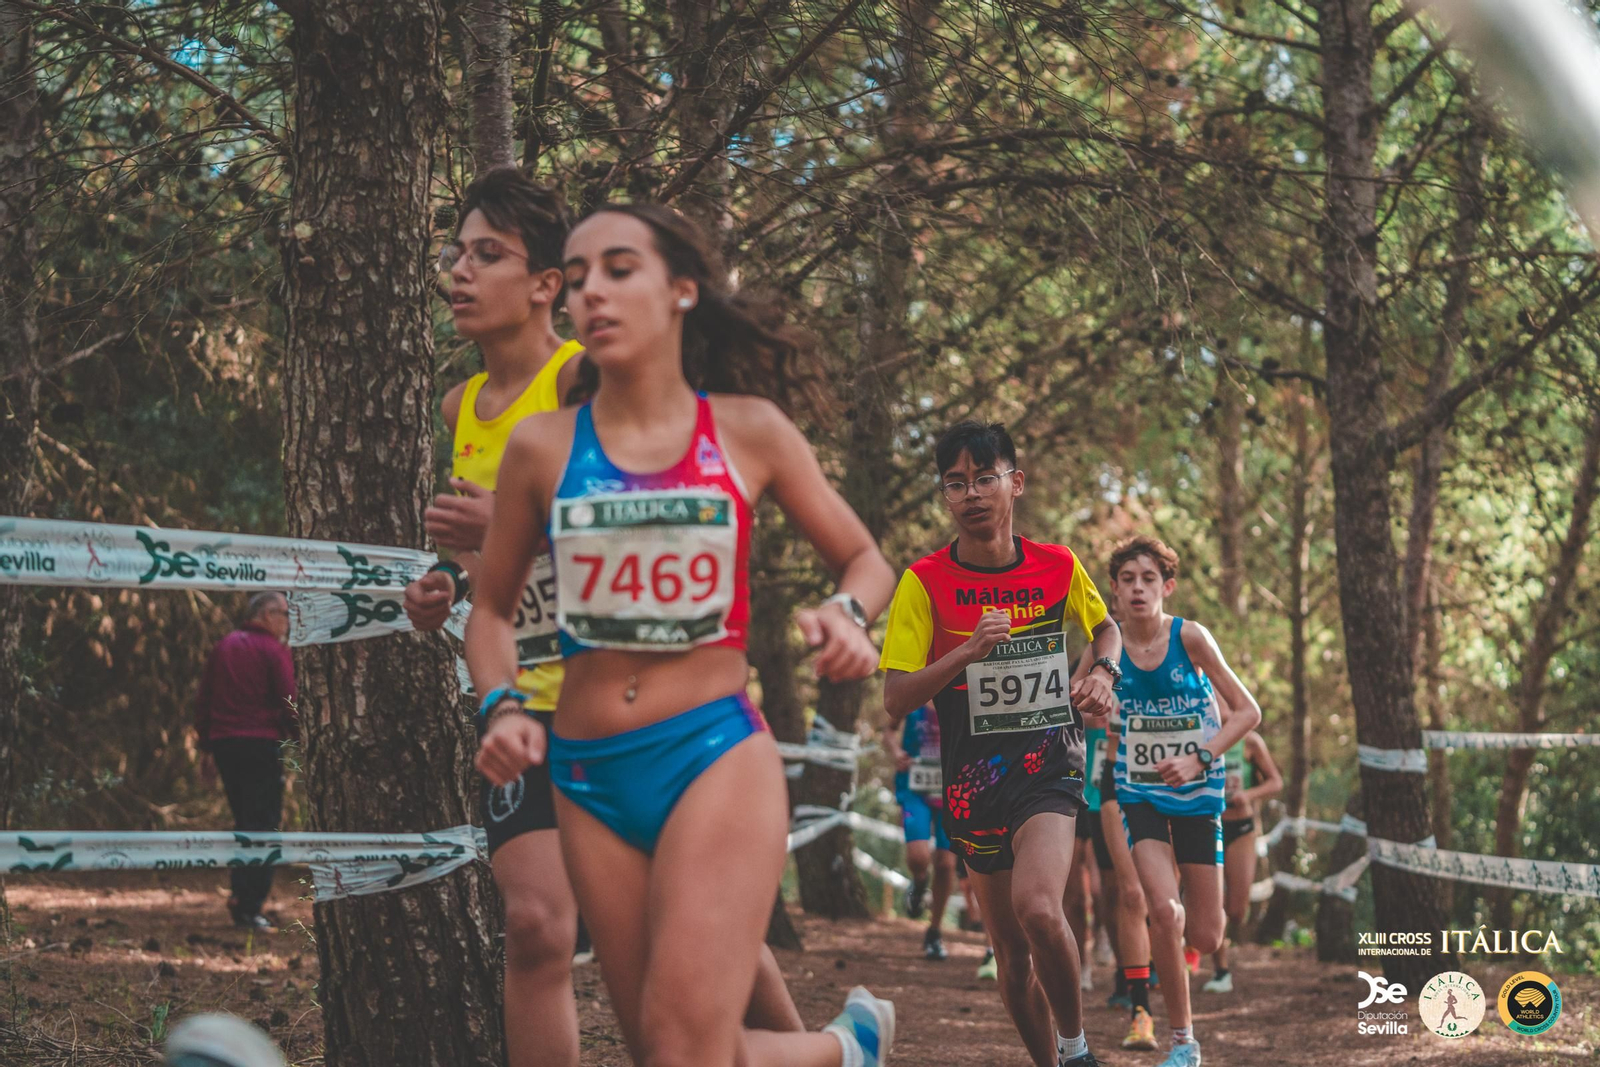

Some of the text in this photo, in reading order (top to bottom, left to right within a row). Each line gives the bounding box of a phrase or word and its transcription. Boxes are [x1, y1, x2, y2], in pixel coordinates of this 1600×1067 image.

[205, 561, 267, 582] Sevilla
[572, 552, 720, 604] 7469
[956, 587, 1045, 607] Málaga
[996, 639, 1043, 655] ITÁLICA
[979, 669, 1064, 708] 5974
[1121, 694, 1191, 714] CHAPIN
